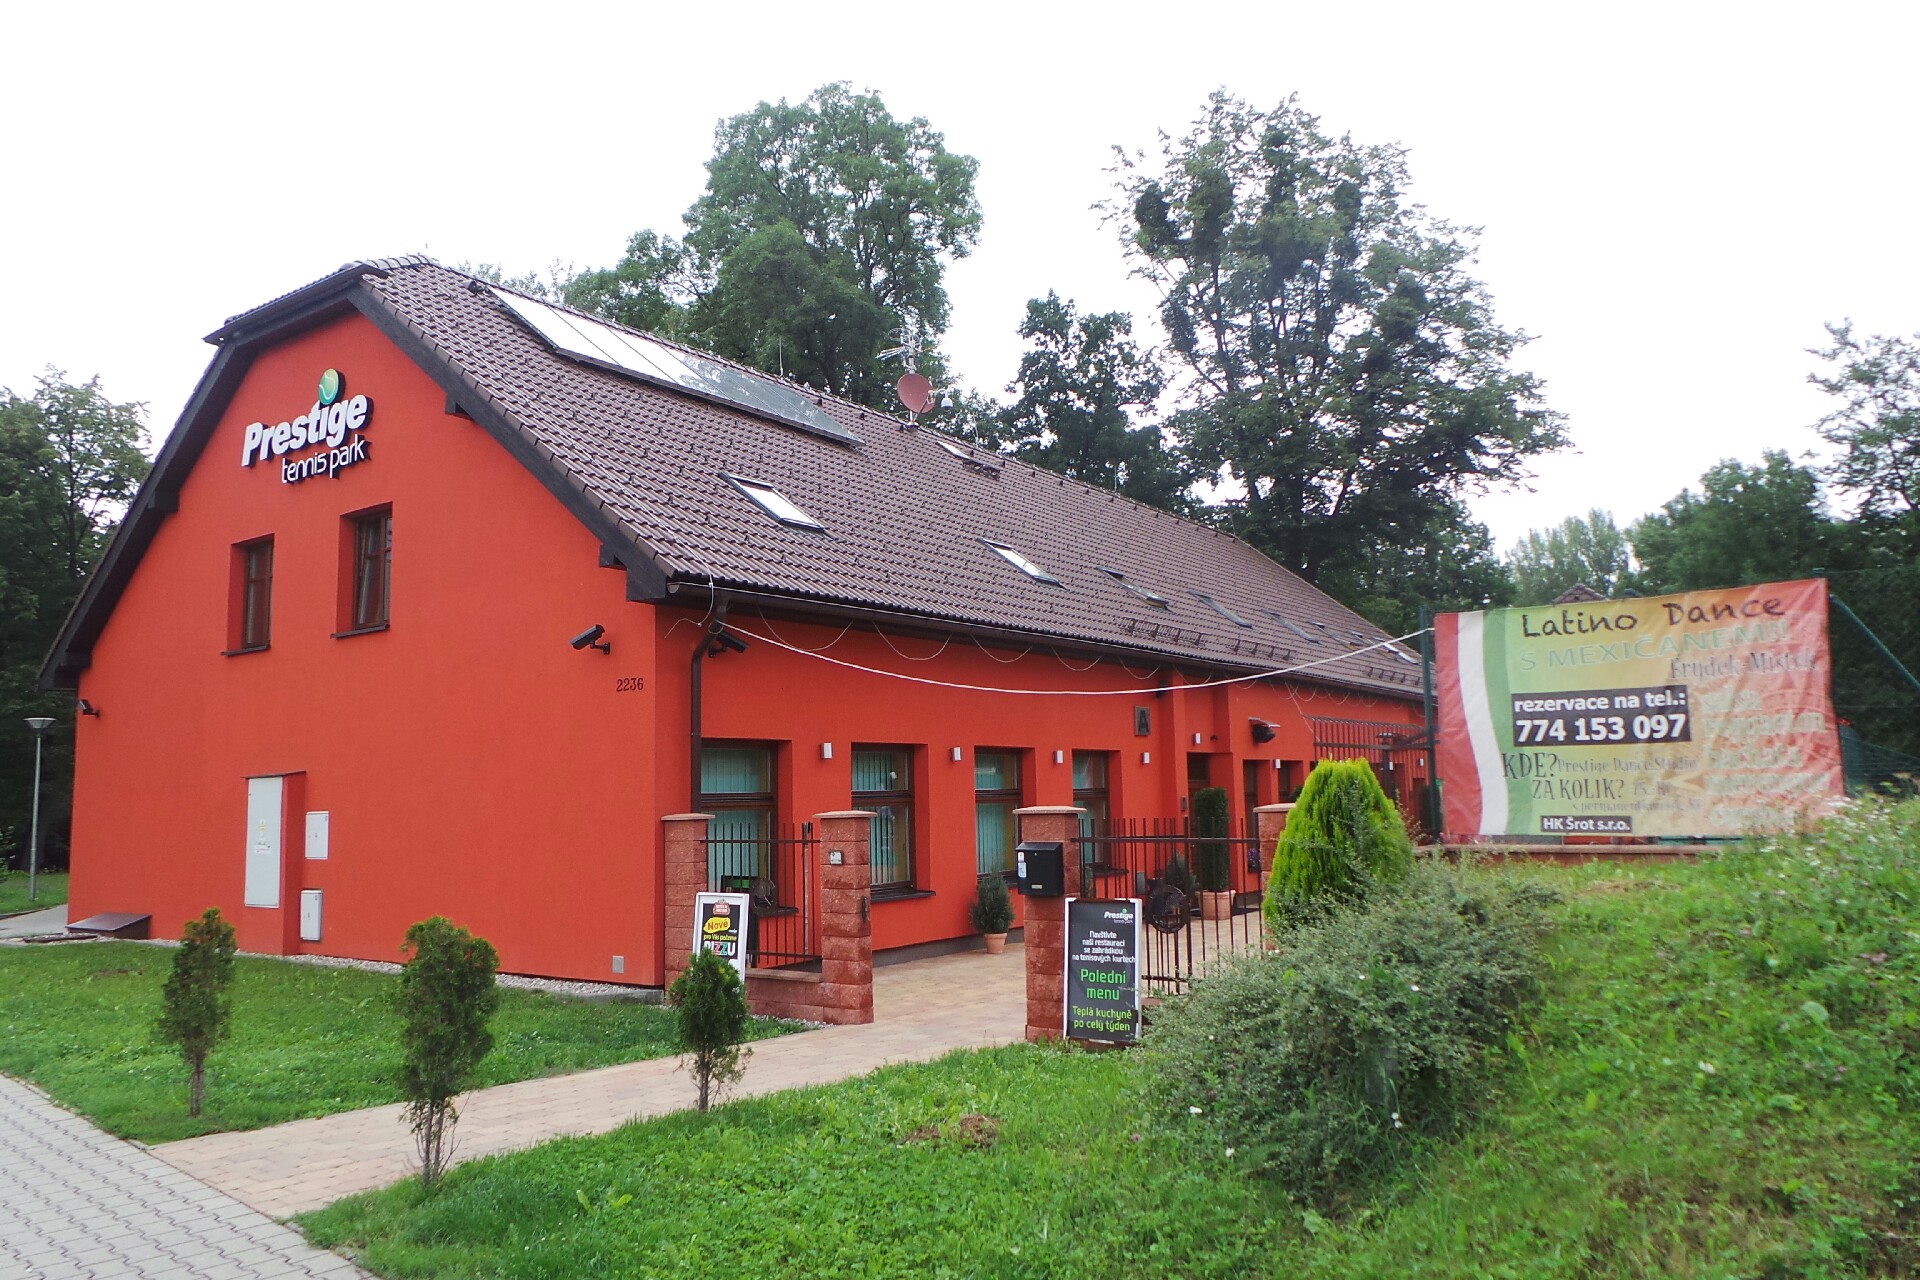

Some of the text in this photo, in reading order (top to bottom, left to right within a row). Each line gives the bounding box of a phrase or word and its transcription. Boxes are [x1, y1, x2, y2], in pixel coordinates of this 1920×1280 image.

[241, 395, 368, 467] Prestige
[281, 434, 365, 483] tennis park
[1522, 598, 1785, 637] Latino Dance
[616, 677, 644, 692] 2236
[1514, 697, 1609, 712] rezervace
[1615, 695, 1640, 709] na
[1645, 689, 1686, 707] tel.:
[1138, 709, 1150, 732] A
[1516, 719, 1567, 742] 774
[1574, 717, 1626, 741] 153
[1632, 714, 1687, 739] 097
[1501, 752, 1558, 779] KDE?
[1532, 779, 1555, 800] ZA
[1559, 778, 1625, 800] KOLIK?
[1543, 816, 1631, 831] HK Šrot s.r.o.
[1104, 911, 1134, 921] Prestige
[1112, 955, 1136, 963] kurtech
[1080, 968, 1126, 984] Polední
[1086, 988, 1120, 1000] menu
[1072, 1005, 1132, 1020] Teplá kuchyně
[1074, 1019, 1131, 1032] po celý týden
